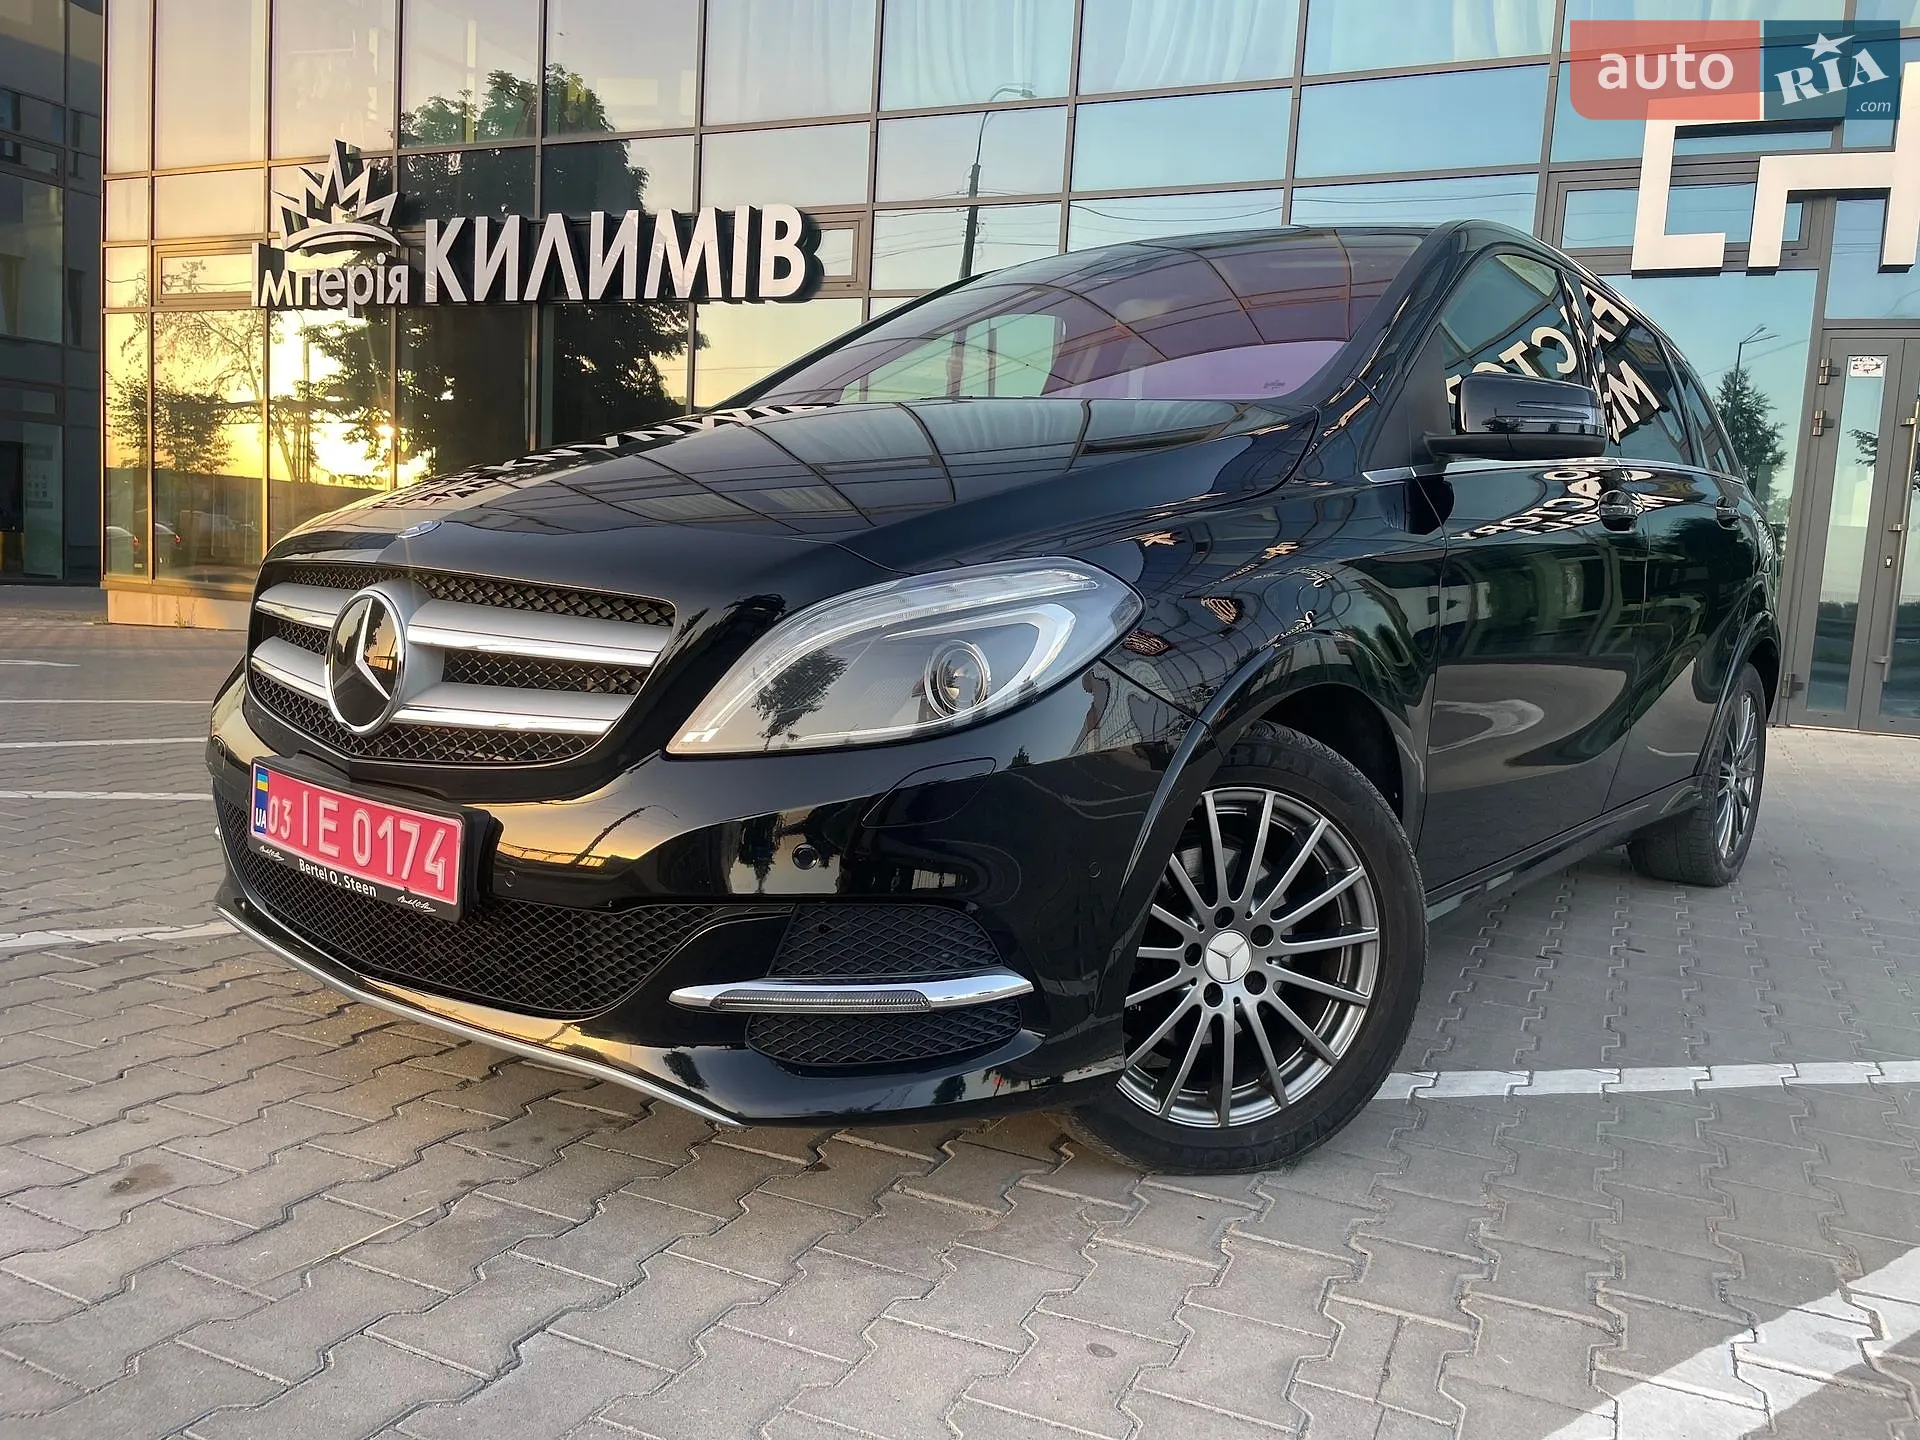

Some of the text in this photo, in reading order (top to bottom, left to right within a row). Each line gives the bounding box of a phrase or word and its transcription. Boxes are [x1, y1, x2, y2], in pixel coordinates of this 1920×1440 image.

[424, 203, 807, 304] КИЛИМІВ
[254, 806, 267, 828] UA
[299, 858, 377, 898] Bertel O. Steen
[352, 808, 447, 892] 0174
